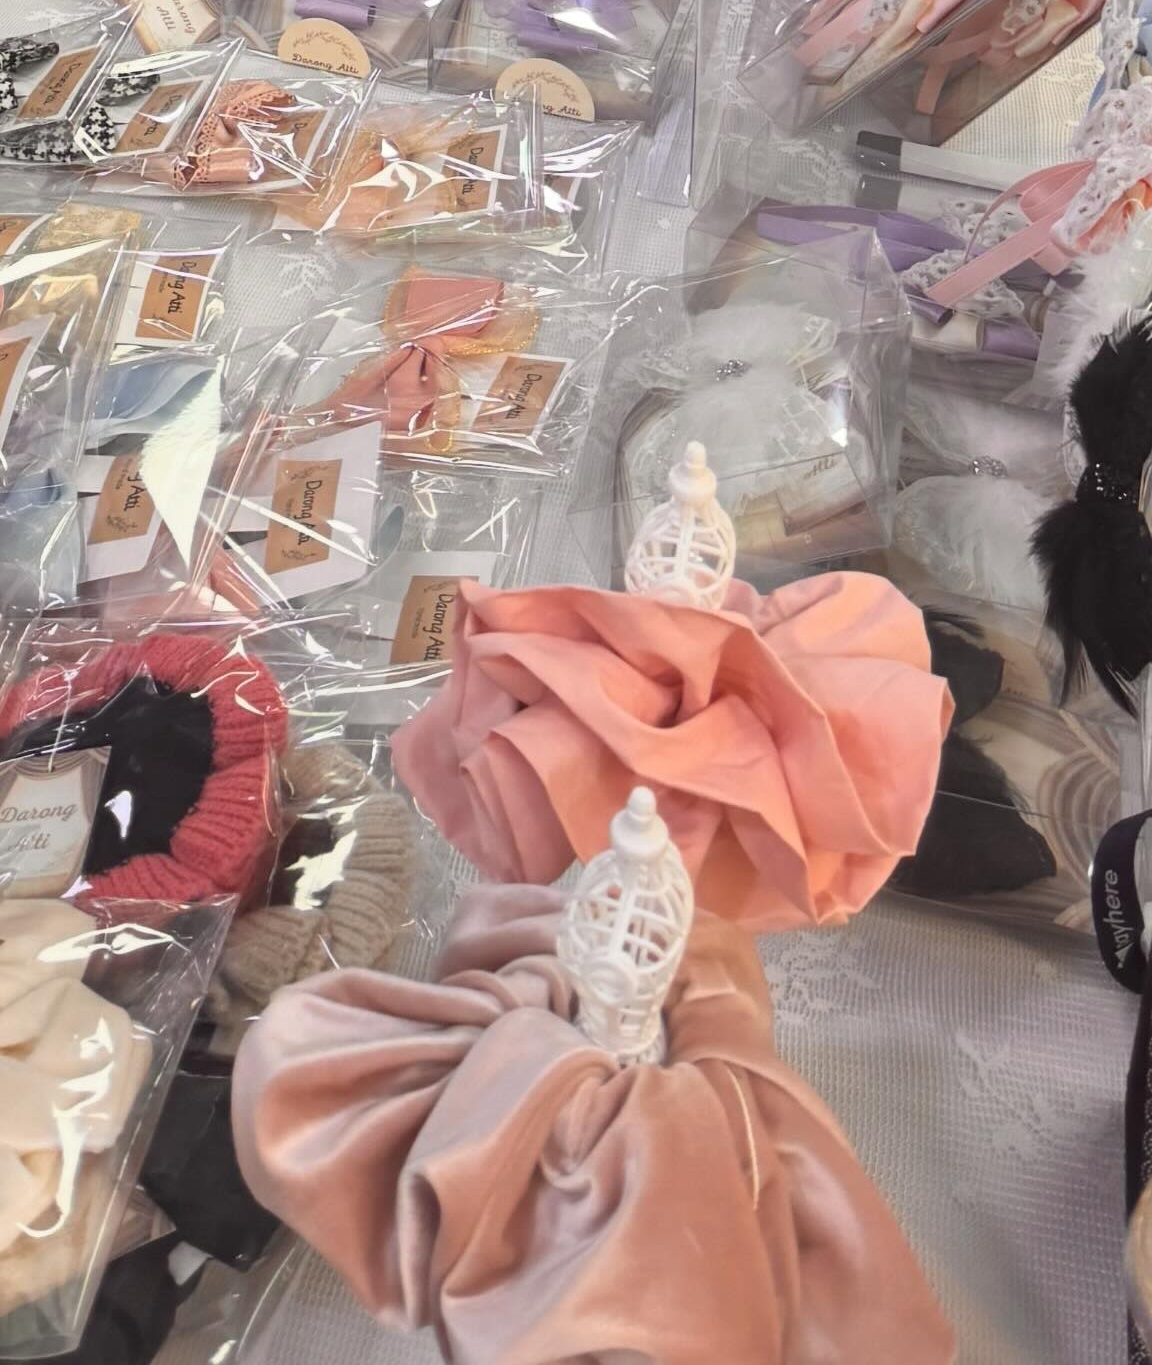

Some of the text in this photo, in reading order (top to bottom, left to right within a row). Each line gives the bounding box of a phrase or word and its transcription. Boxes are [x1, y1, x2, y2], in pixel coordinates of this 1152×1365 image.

[291, 52, 360, 75] Darong Atti
[167, 261, 198, 314] Dang Atti
[123, 485, 146, 511] Atti
[293, 479, 323, 546] Darong Ati
[422, 593, 456, 662] Darong Atti
[1103, 869, 1136, 967] ayhere
